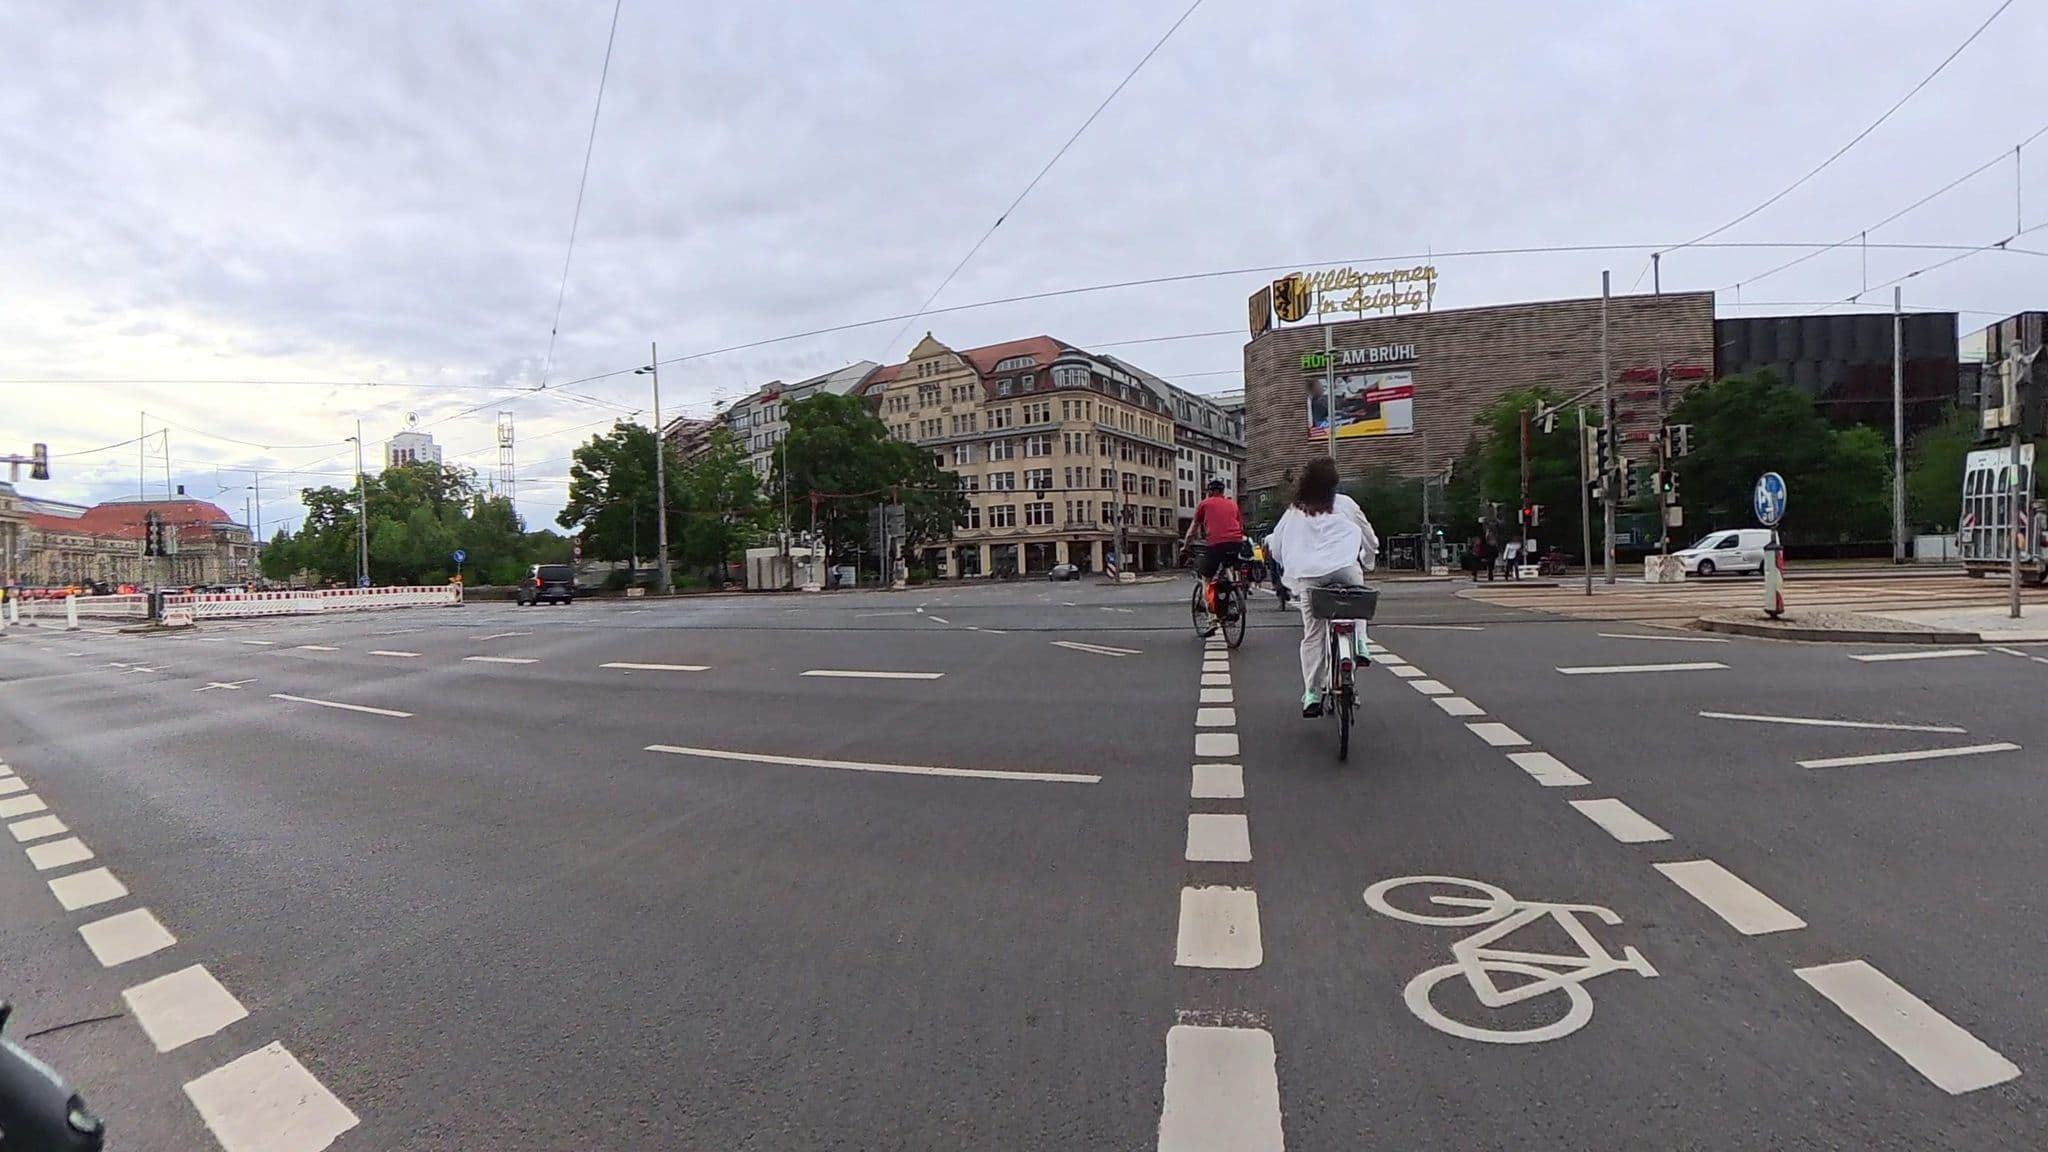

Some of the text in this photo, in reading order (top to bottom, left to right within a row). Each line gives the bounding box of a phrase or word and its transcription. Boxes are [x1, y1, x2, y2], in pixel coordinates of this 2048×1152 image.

[1294, 266, 1438, 295] Willkommen
[1318, 296, 1337, 314] in
[1342, 349, 1366, 365] AM
[1369, 344, 1420, 363] BRÜHL
